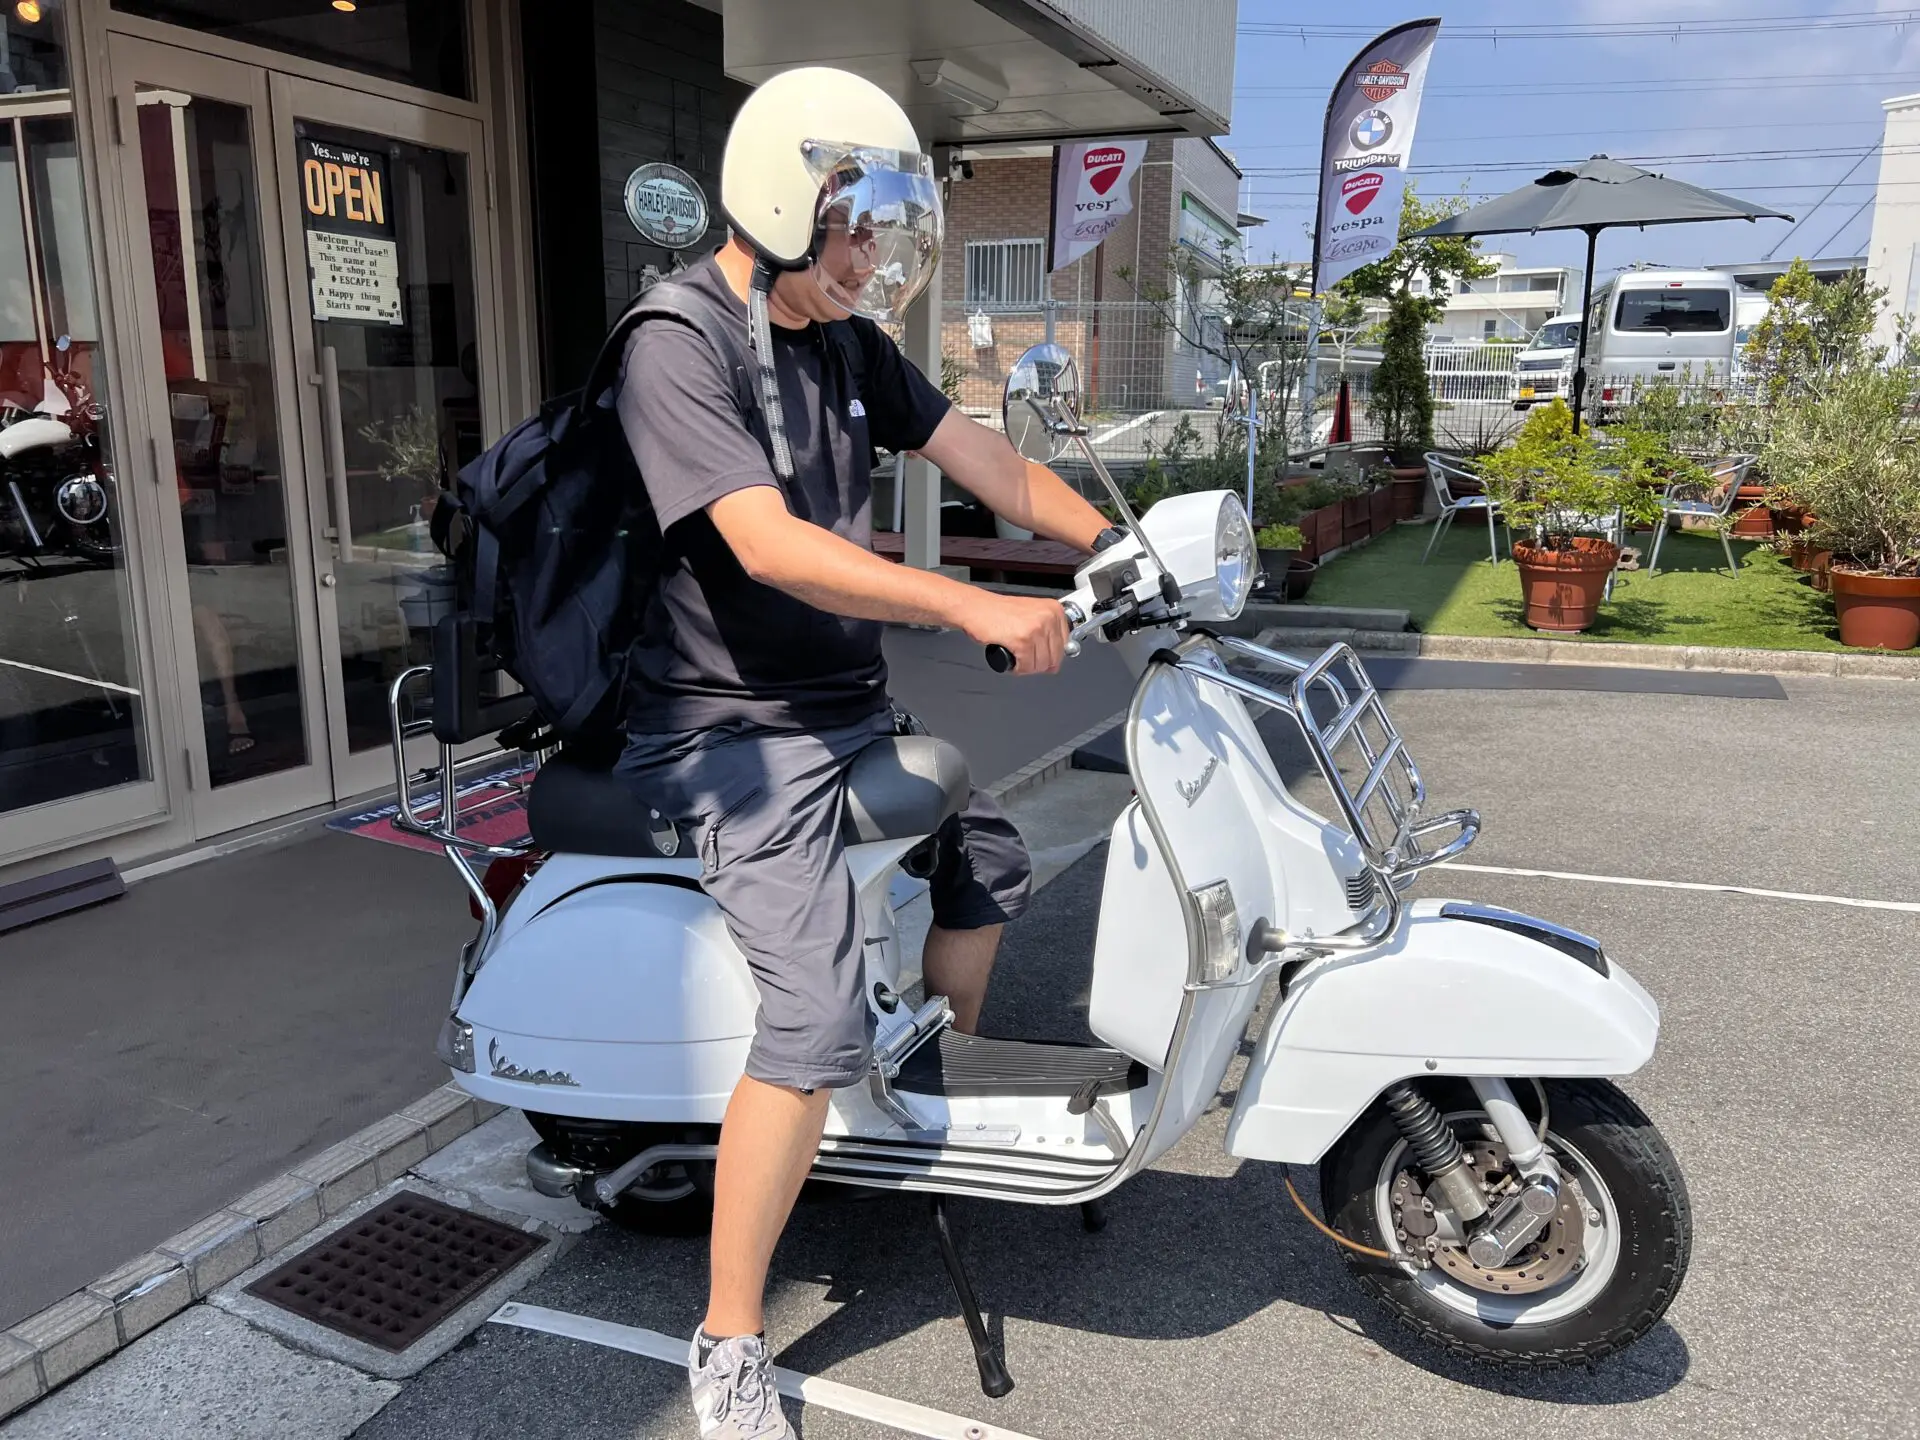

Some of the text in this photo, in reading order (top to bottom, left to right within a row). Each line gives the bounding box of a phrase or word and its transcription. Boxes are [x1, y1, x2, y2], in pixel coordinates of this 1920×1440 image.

[1356, 75, 1405, 86] HARLEY-DAVIDSON
[1366, 87, 1392, 100] CYCLES
[1356, 110, 1391, 124] BMW
[342, 152, 370, 166] we're
[1086, 153, 1122, 163] DUCATI
[1334, 155, 1387, 170] TRIUMPH
[1344, 177, 1381, 190] DUCATI
[304, 159, 384, 224] OPEN
[638, 190, 697, 220] HARLEY-DAVIDSON
[1331, 216, 1385, 234] vespa
[316, 233, 364, 247] Welcom to
[336, 244, 361, 253] secret
[319, 252, 336, 262] This
[343, 257, 364, 265] name
[330, 263, 343, 272] the
[347, 266, 365, 276] shop
[340, 275, 371, 287] ESCAPE
[318, 287, 381, 303] A Happy thing
[326, 300, 371, 312] Starts now
[349, 805, 400, 821] THE
[699, 1335, 716, 1348] THE
